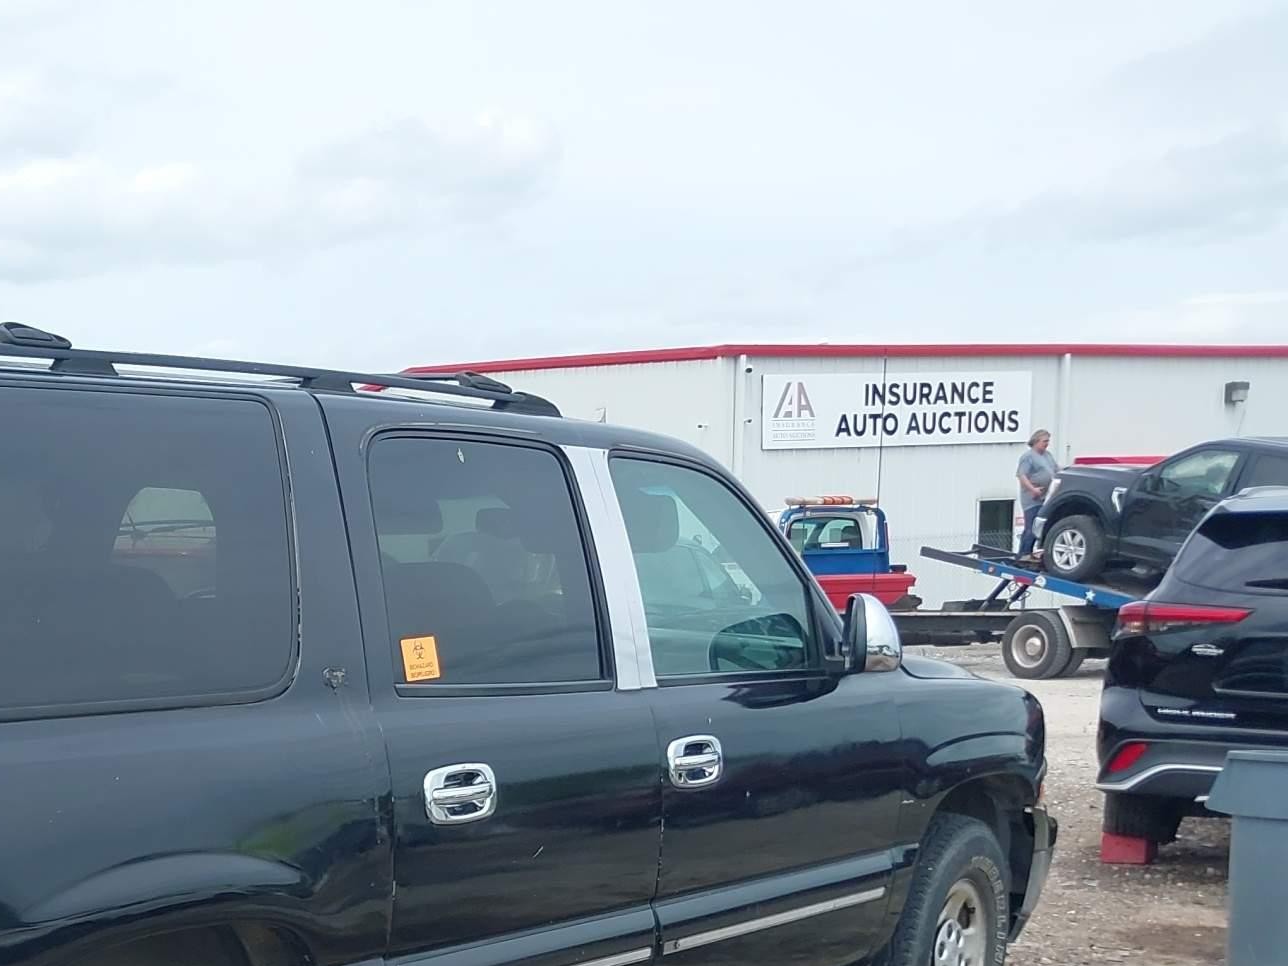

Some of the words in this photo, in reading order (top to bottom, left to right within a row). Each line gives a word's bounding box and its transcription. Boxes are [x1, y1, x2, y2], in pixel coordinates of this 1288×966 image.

[864, 381, 995, 406] INSURANCE
[835, 412, 899, 437] AUTO
[906, 410, 1020, 435] AUCTIONS
